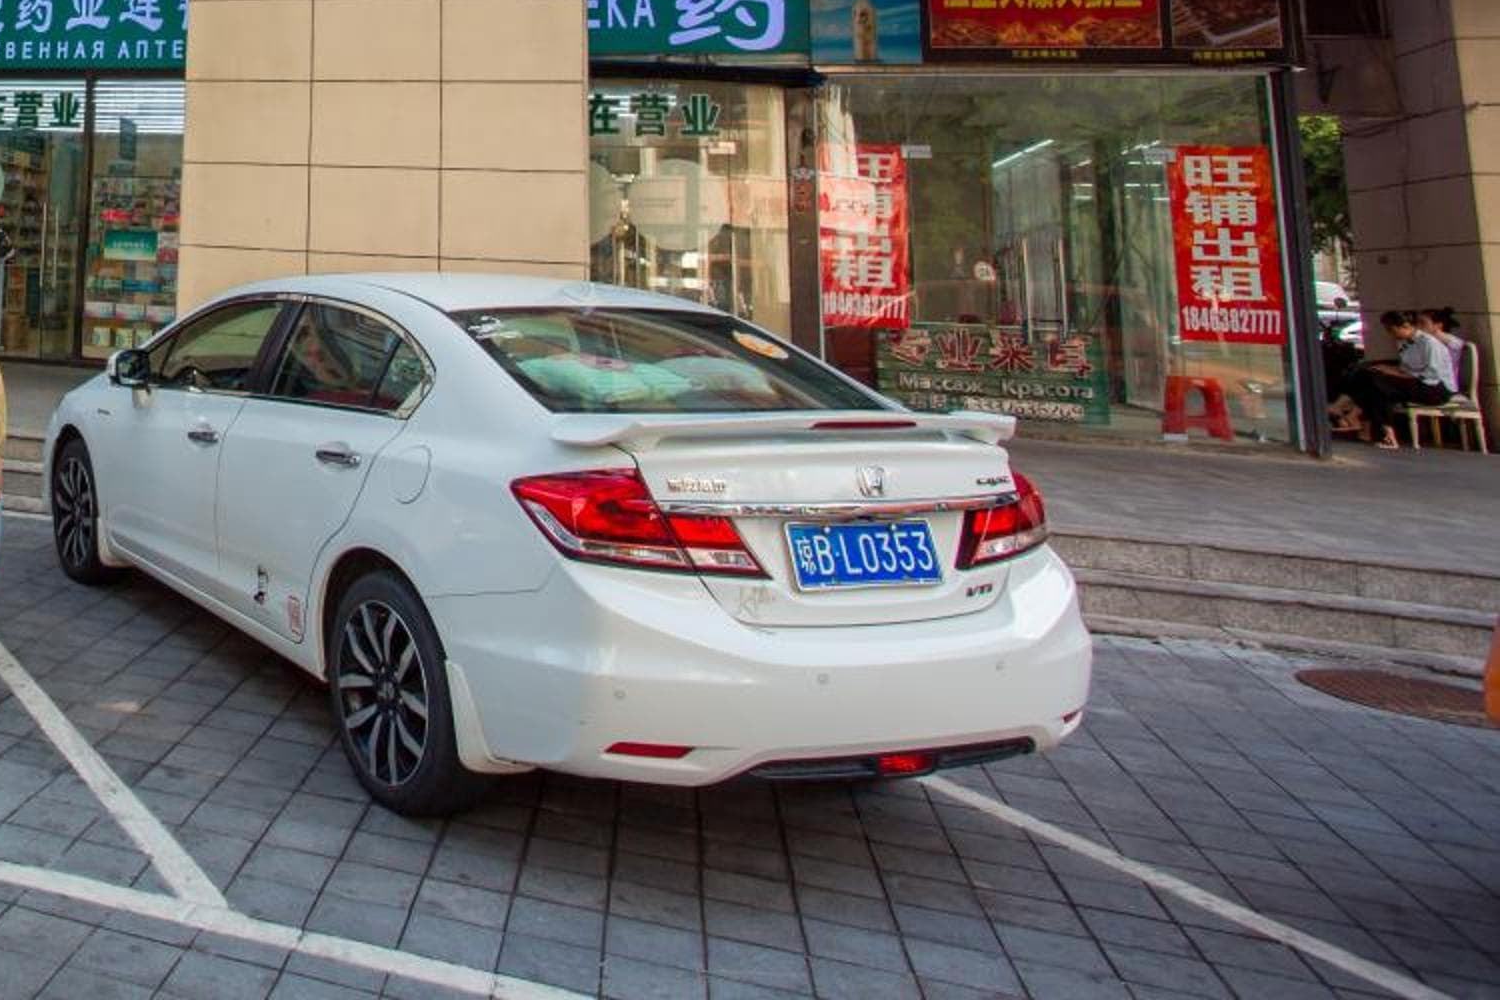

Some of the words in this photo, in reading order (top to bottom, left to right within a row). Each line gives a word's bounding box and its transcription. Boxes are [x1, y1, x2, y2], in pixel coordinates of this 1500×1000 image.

[589, 93, 721, 137] 在营业
[1183, 155, 1268, 302] 旺铺出租
